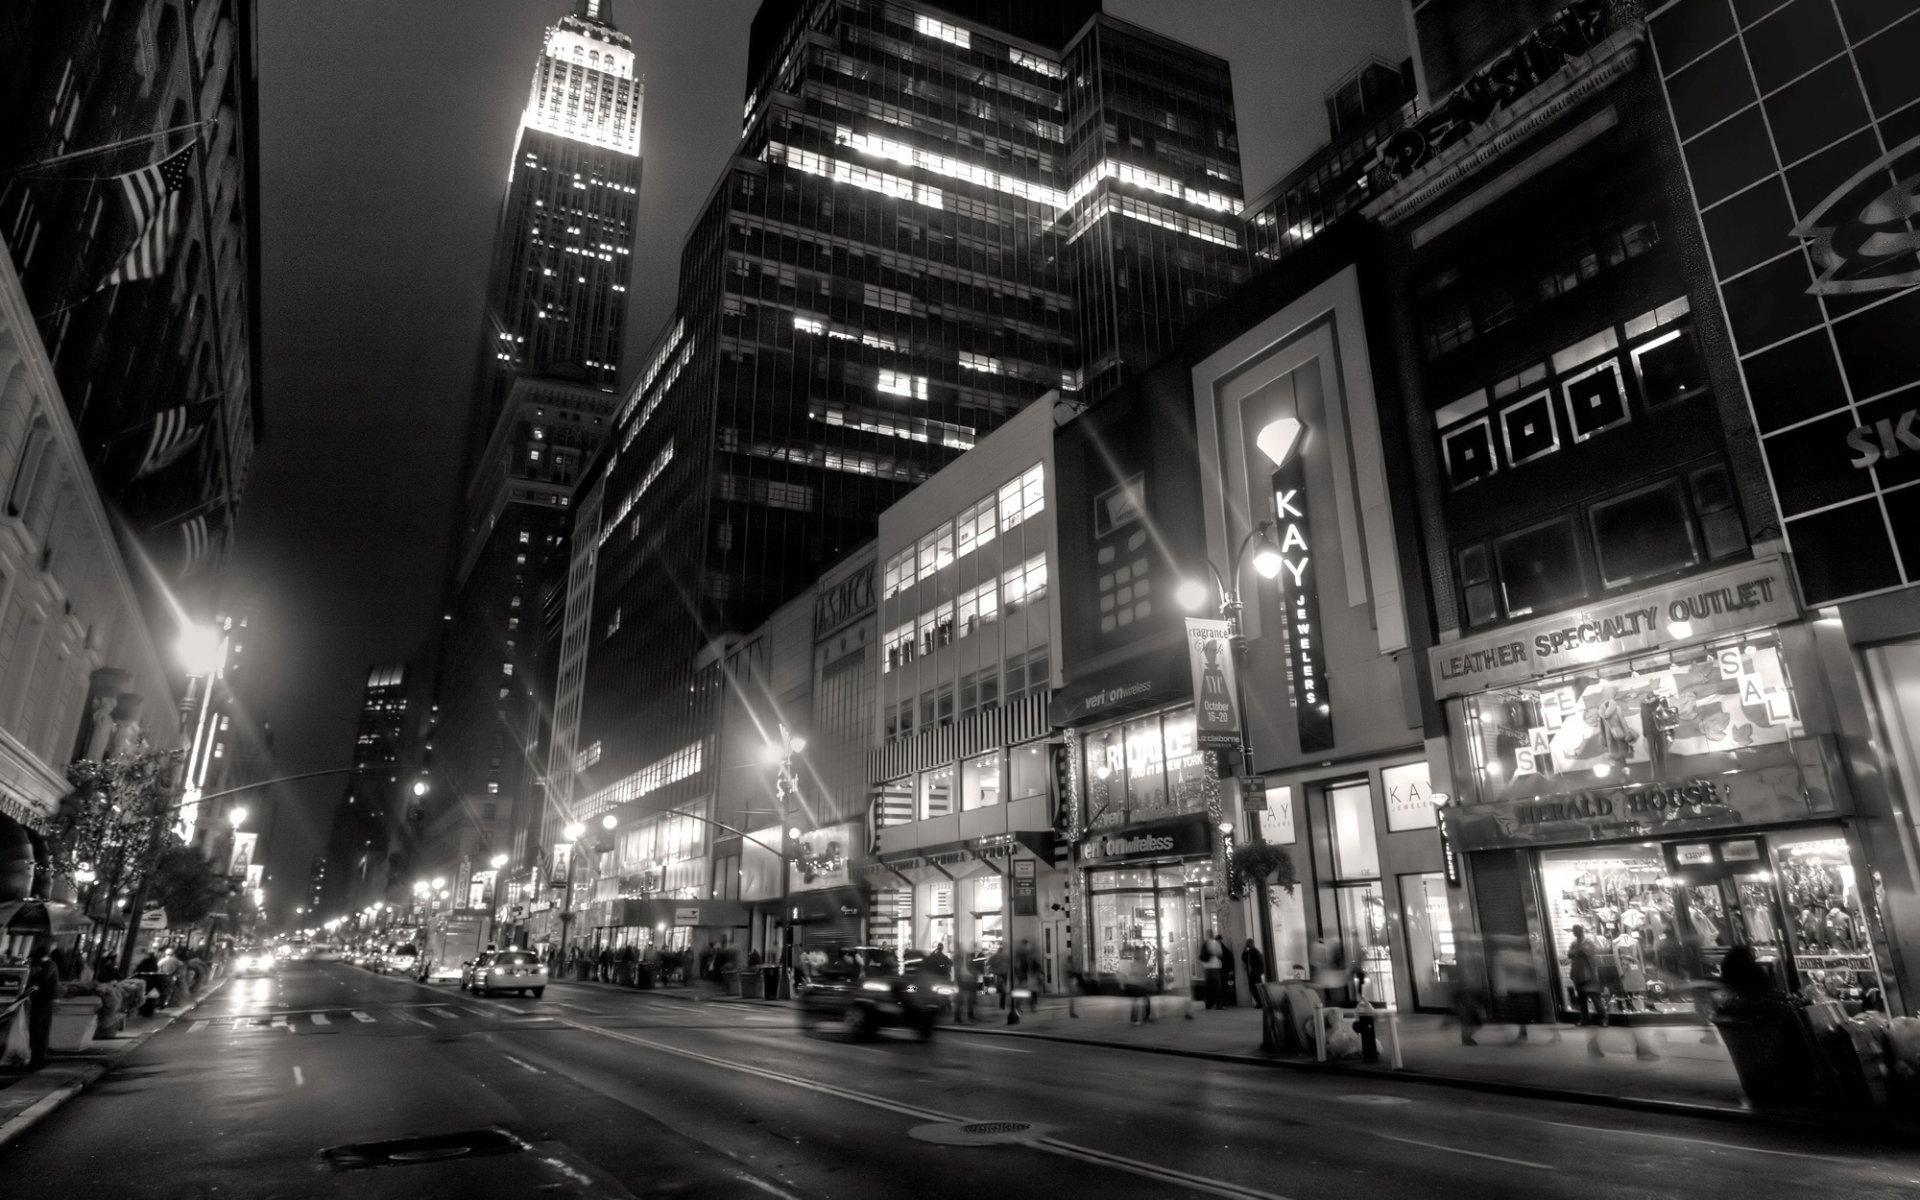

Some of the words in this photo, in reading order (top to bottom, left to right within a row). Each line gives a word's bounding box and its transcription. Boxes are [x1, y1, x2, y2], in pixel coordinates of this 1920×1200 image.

[1276, 489, 1309, 587] KAY
[1440, 641, 1527, 680] LEATHER
[1535, 607, 1658, 657] SPECIALTY
[1669, 577, 1775, 623] OUTLET
[1296, 594, 1316, 704] JEWELERS
[1206, 676, 1224, 694] NYC
[1204, 699, 1229, 712] October
[1208, 711, 1228, 722] 16-20
[1183, 753, 1203, 768] YORK
[1517, 797, 1613, 825] HERALD
[1629, 777, 1721, 813] HOUSE
[1266, 804, 1289, 821] AY
